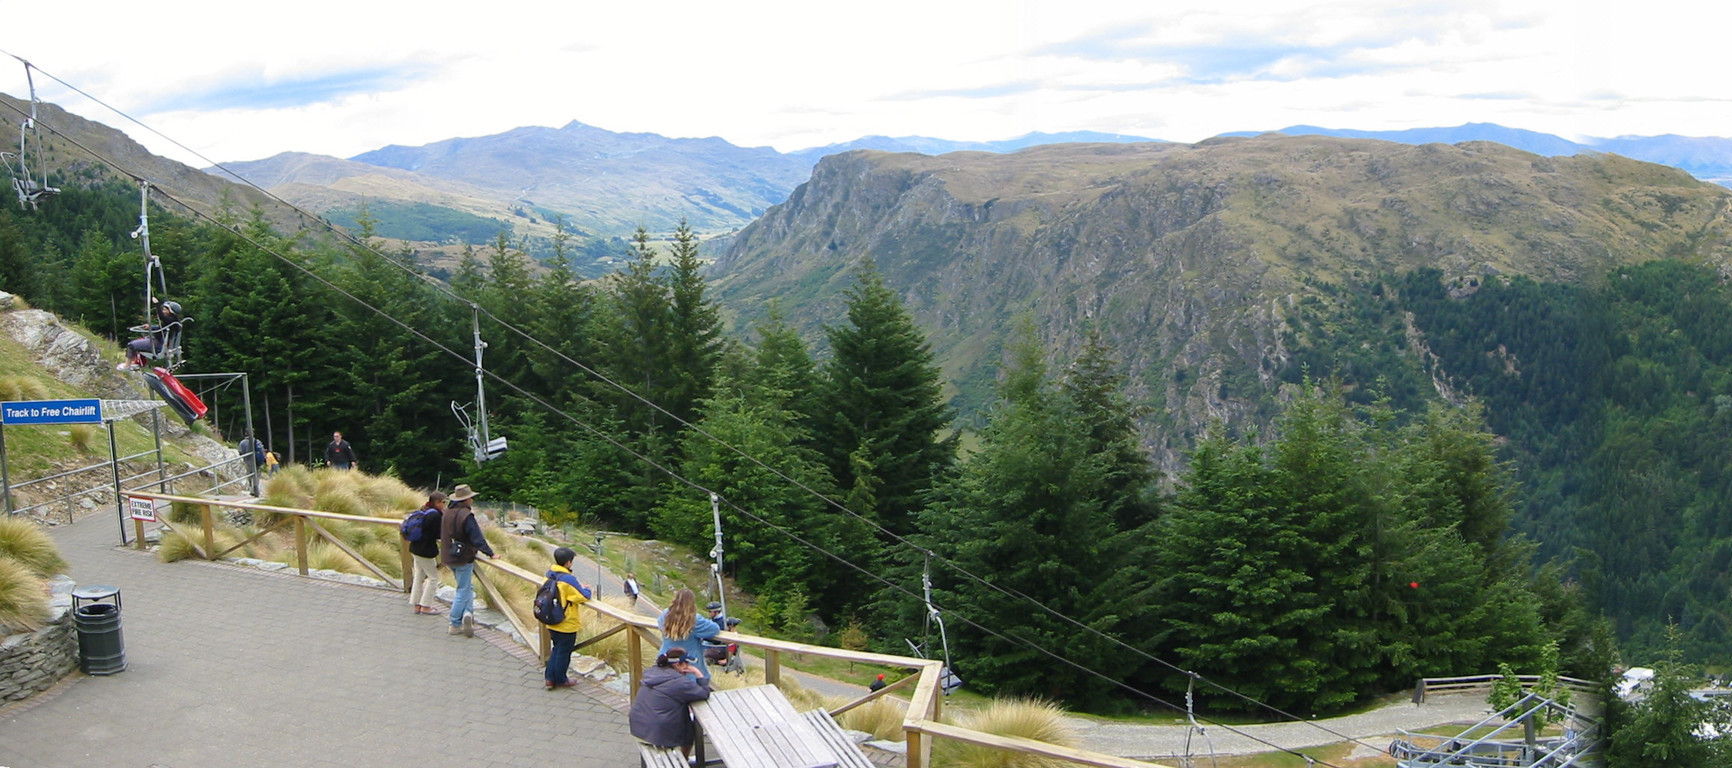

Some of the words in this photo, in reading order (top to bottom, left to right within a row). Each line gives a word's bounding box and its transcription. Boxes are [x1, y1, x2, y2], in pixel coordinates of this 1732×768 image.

[6, 408, 29, 418] Track
[31, 408, 40, 417] to
[41, 407, 60, 417] Free
[62, 405, 96, 416] Chairlift
[131, 500, 152, 509] EXTREME
[132, 508, 142, 516] FIRE
[142, 509, 153, 517] RISK
